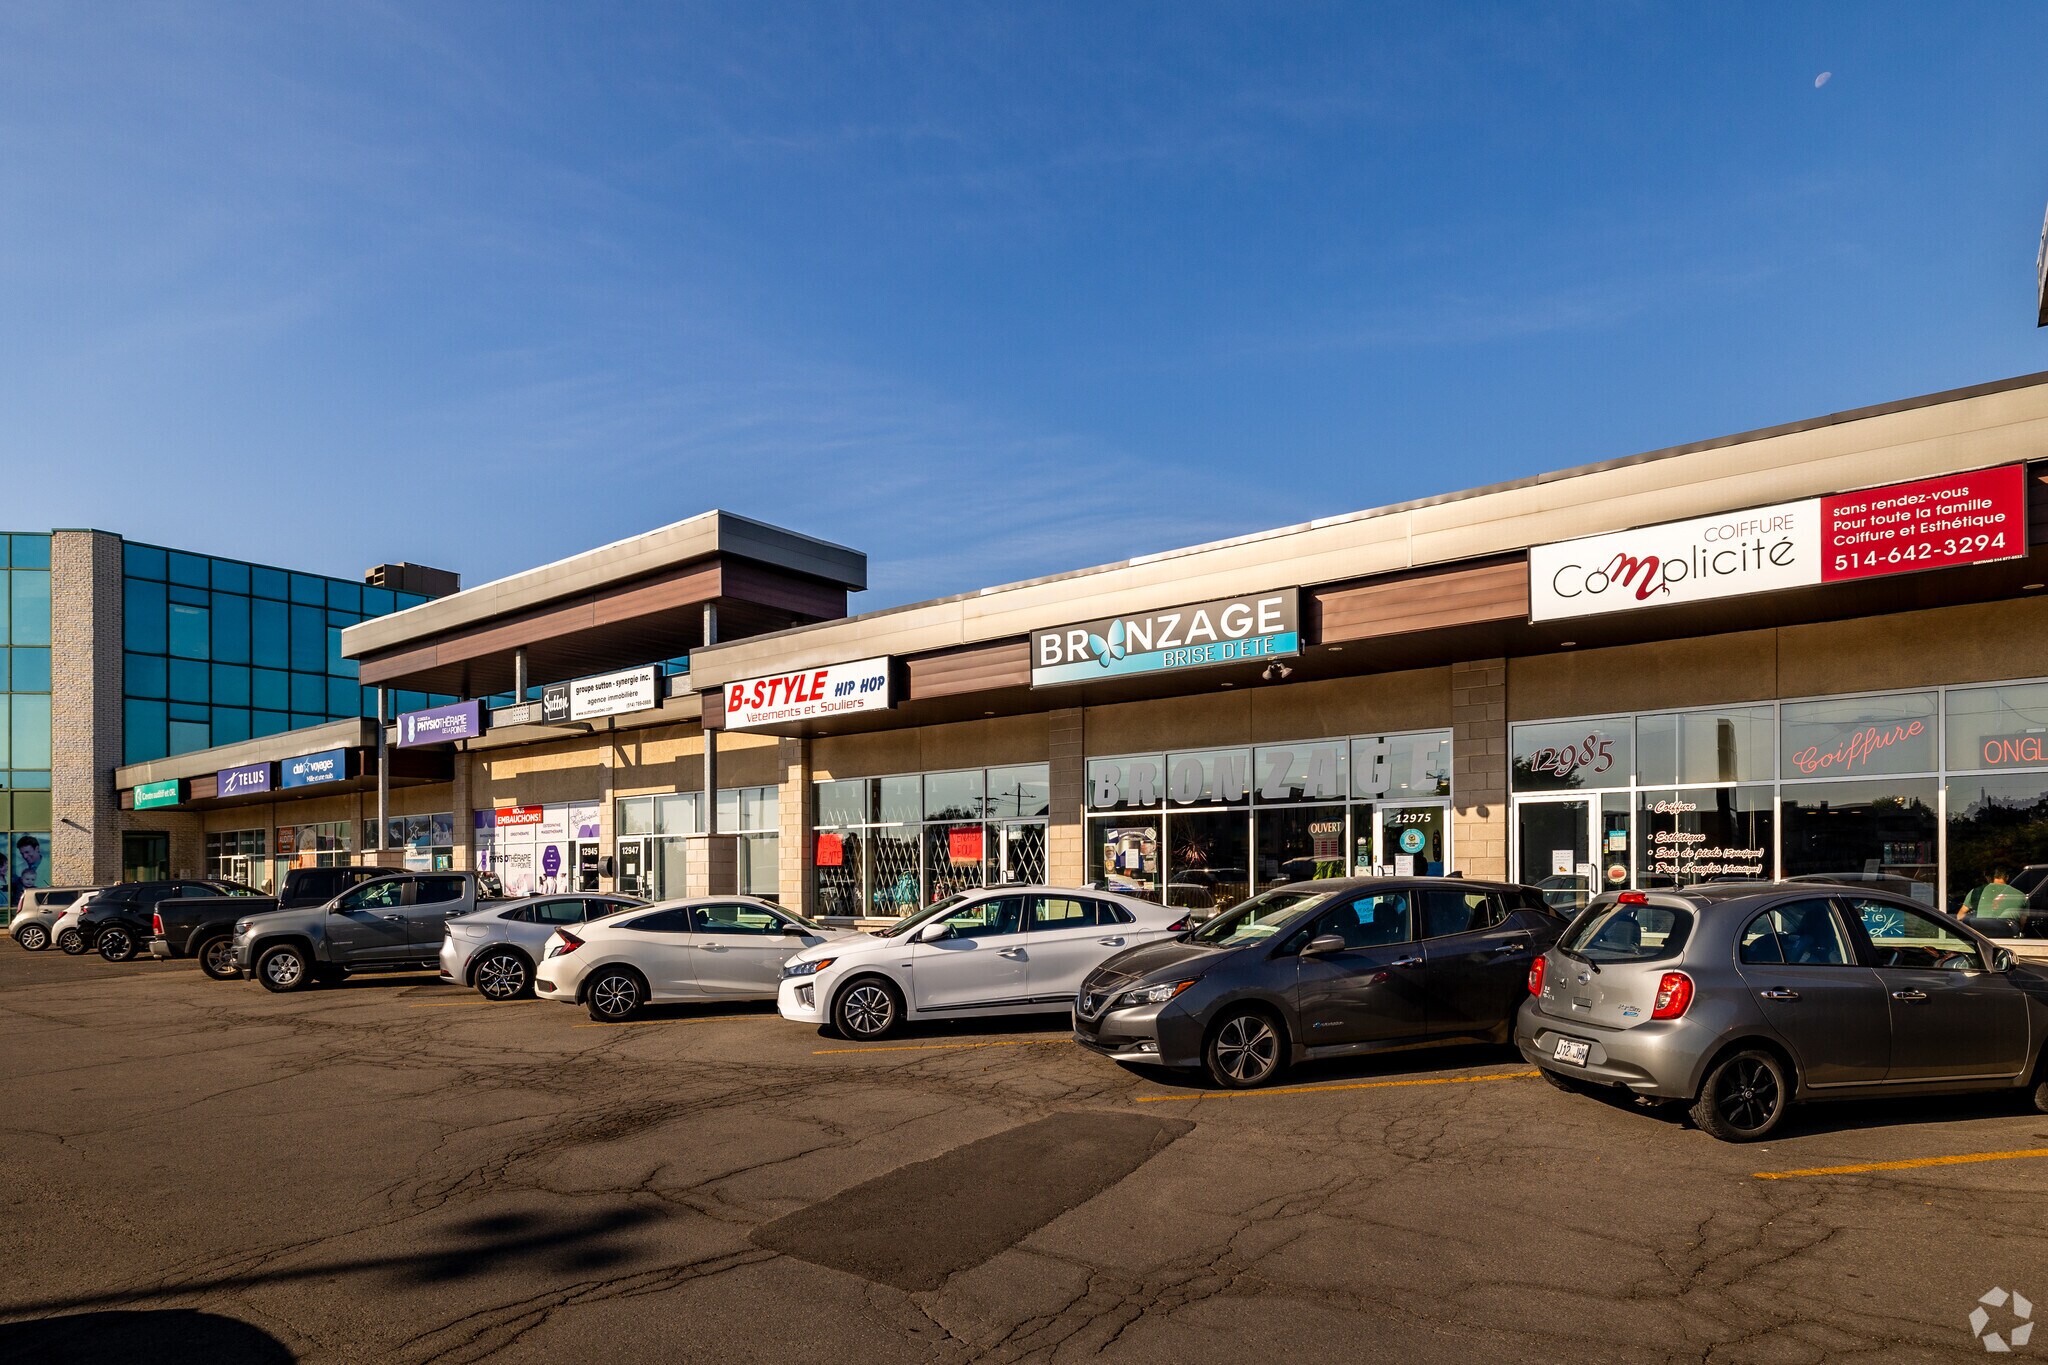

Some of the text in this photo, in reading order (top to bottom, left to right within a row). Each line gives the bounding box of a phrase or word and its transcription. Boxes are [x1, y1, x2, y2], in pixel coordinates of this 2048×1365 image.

[1833, 486, 1969, 517] sans rendez-vous
[1833, 498, 1992, 532] Pour toute la famille
[1704, 514, 1794, 542] COIFFURE
[1833, 512, 2006, 546] Coiffure et Esthétique
[1834, 531, 2006, 571] 514-642-3294
[1553, 536, 1795, 601] Complicité
[1040, 597, 1285, 666] BRNZAGE
[1163, 635, 1275, 668] BRISE D'ÉTÉ
[576, 684, 594, 695] groupe
[595, 681, 612, 691] sutton
[615, 675, 639, 688] synergie
[639, 673, 651, 682] inc.
[727, 670, 885, 713] B-STYLE HIP HOP
[544, 694, 569, 713] Sutton
[587, 696, 607, 706] agence
[804, 704, 816, 715] et
[820, 698, 864, 713] Souliers
[1530, 734, 1616, 777] 12985
[1792, 720, 1925, 774] Coiffure
[310, 759, 334, 773] voyages
[1093, 739, 1444, 808] BRONZAGE
[239, 770, 264, 786] TELUS
[1395, 813, 1431, 823] 12975
[1654, 800, 1697, 815] Coiffure
[1310, 821, 1342, 834] OUVERT
[489, 853, 532, 863] PHYSOTHÉRAPIE
[582, 847, 598, 856] 12945
[622, 846, 639, 855] 12947
[1681, 847, 1695, 858] de
